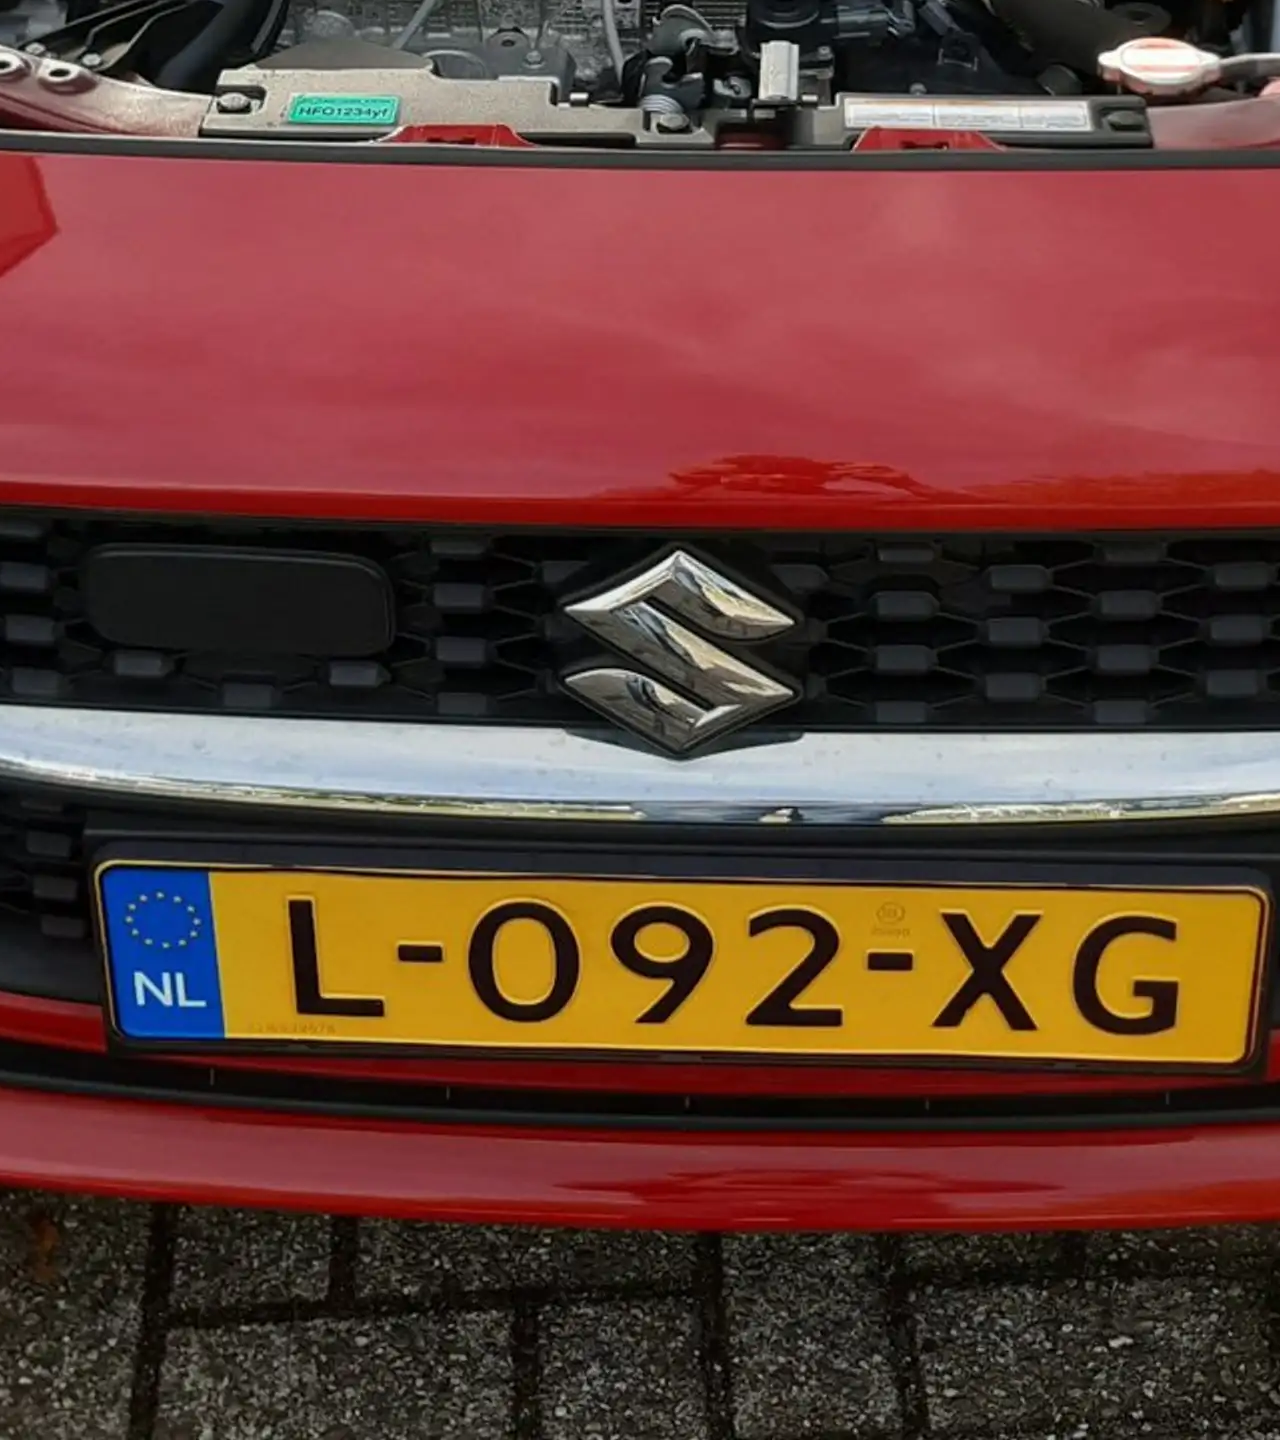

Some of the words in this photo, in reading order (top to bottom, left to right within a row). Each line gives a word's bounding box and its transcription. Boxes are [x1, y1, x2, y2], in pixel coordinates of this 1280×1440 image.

[298, 105, 389, 119] HFO1234yf
[286, 898, 1182, 1036] L-092-XG
[132, 968, 207, 1010] NL
